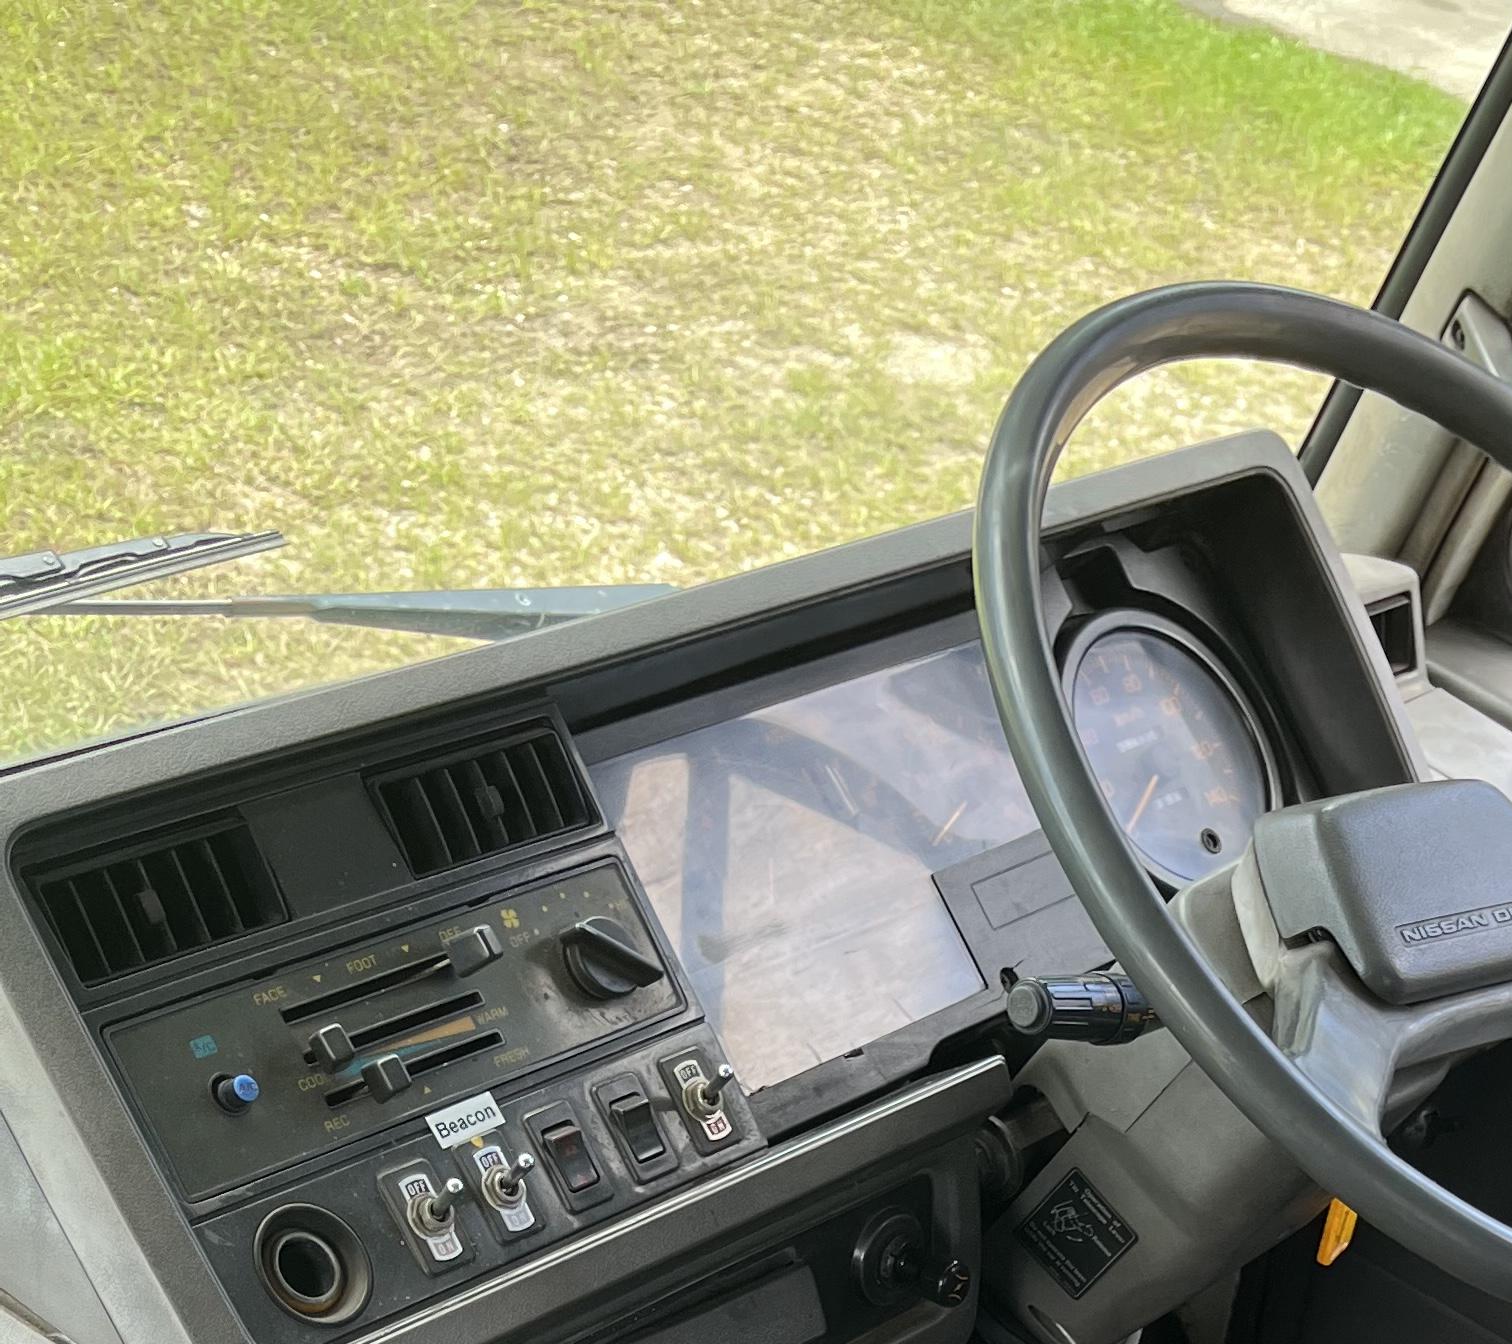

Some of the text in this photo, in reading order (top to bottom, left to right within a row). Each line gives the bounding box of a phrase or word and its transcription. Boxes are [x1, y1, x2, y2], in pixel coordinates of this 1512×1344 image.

[1400, 913, 1490, 943] NISSAN
[509, 931, 531, 948] OFF
[346, 954, 377, 974] FOOT
[253, 985, 288, 1005] FACE
[475, 1006, 509, 1025] WARM
[680, 1065, 698, 1080] OFF
[323, 1114, 351, 1133] REC
[435, 1105, 497, 1139] Beacon
[481, 1153, 500, 1168] OFF
[406, 1181, 429, 1196] OFF
